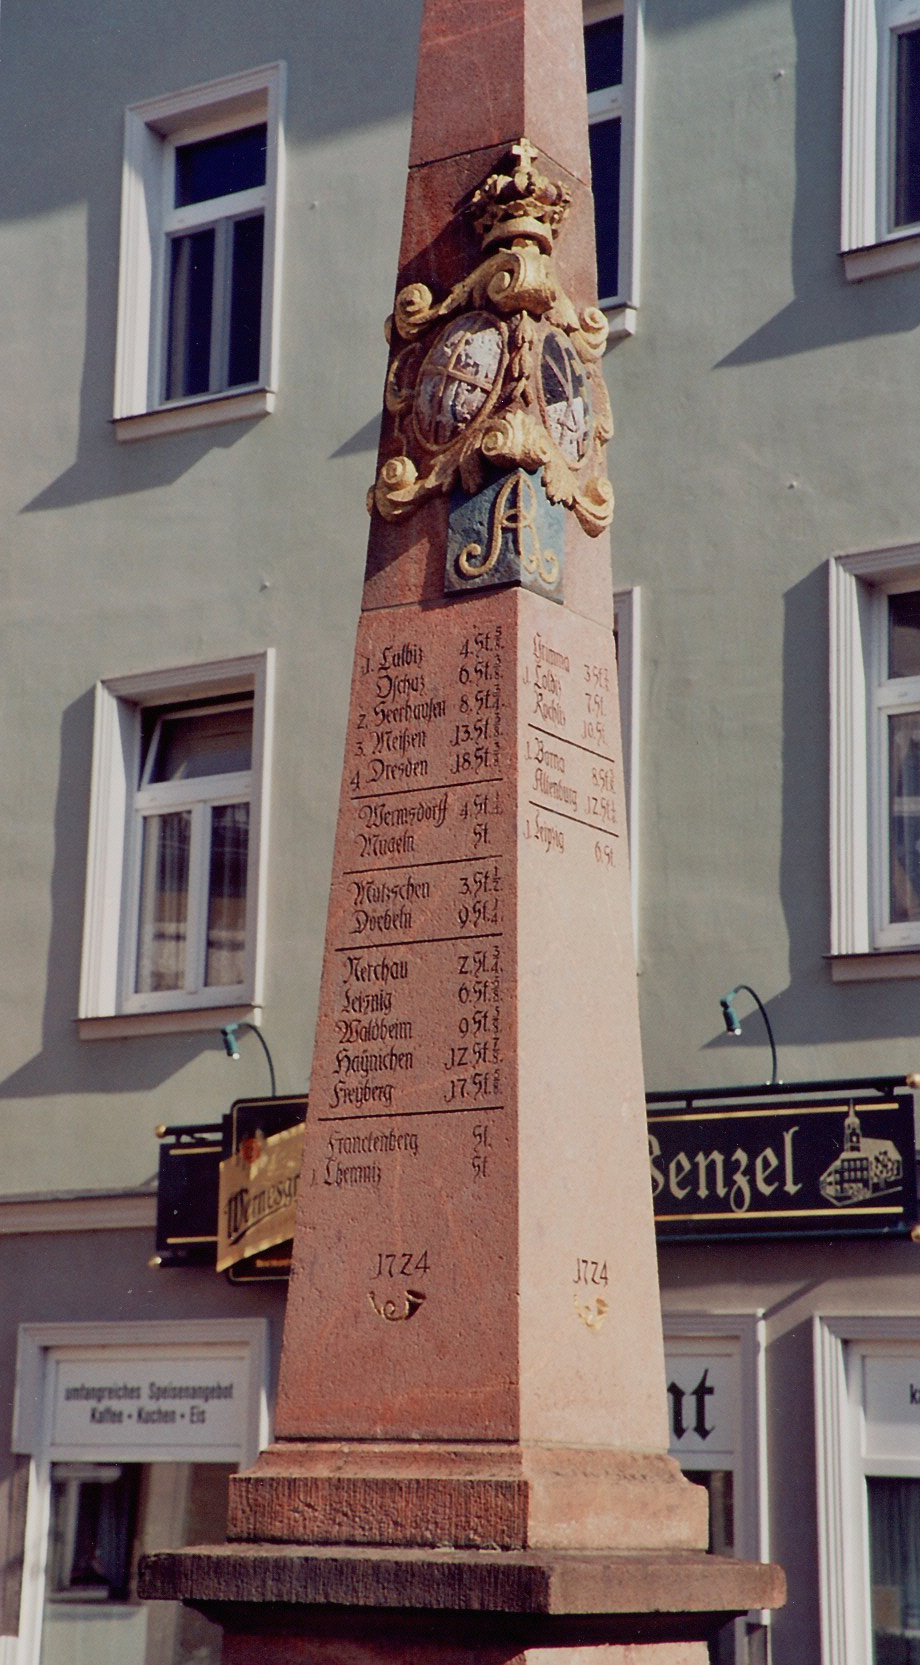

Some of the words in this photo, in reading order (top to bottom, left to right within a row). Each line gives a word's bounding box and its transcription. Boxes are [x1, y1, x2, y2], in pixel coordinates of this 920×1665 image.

[534, 737, 565, 773] Borna
[366, 758, 428, 784] Dresden
[358, 792, 449, 829] Wermsdorff
[343, 956, 408, 984] Nerchau
[334, 1017, 413, 1044] Waldheim
[370, 1250, 431, 1280] 1724
[573, 1258, 608, 1287] 1724
[65, 1383, 141, 1403] umfangreiches
[148, 1381, 234, 1403] Speisenangebot
[909, 1383, 920, 1404] k
[90, 1406, 123, 1424] Kaffee
[136, 1406, 176, 1424] Kuchen
[189, 1405, 206, 1424] Eis
